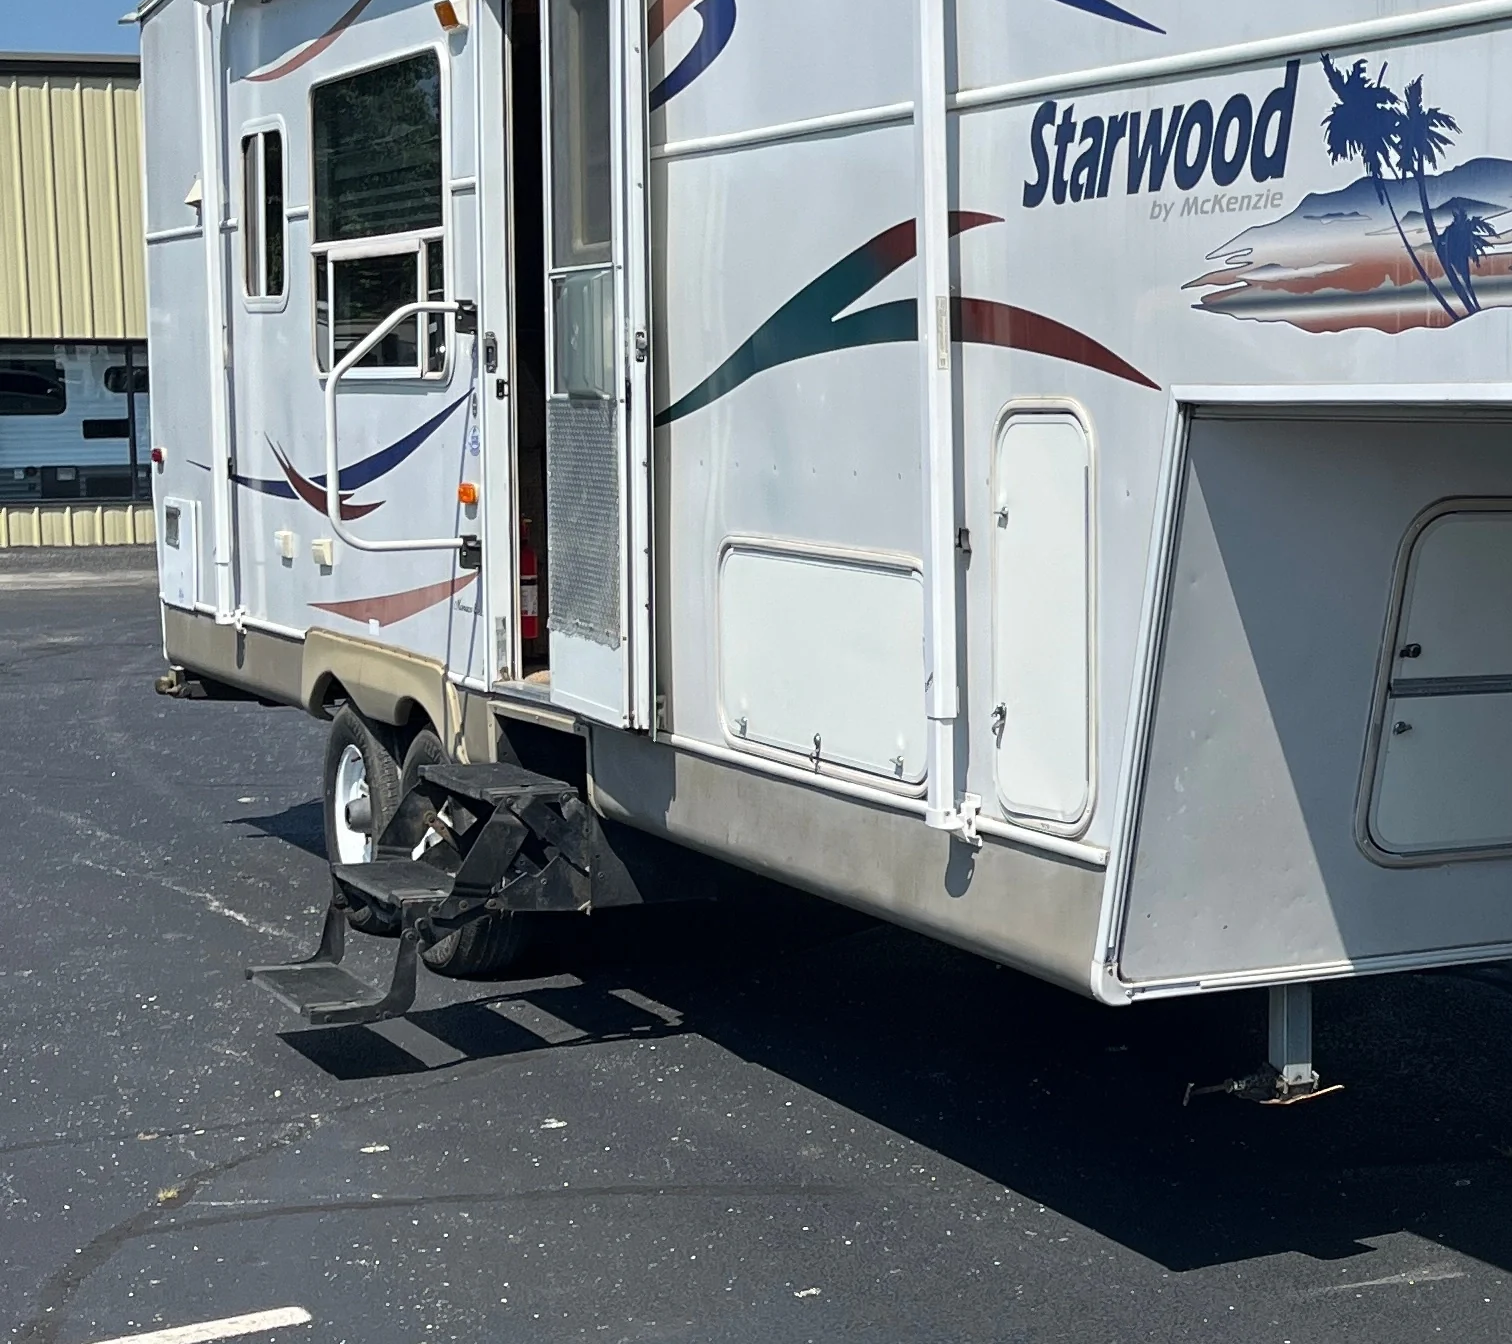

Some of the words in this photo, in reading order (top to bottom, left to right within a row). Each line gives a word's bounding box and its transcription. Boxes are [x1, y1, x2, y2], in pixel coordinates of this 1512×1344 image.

[1022, 59, 1300, 208] Starwood
[1149, 200, 1175, 222] by
[1179, 189, 1284, 217] McKenzie
